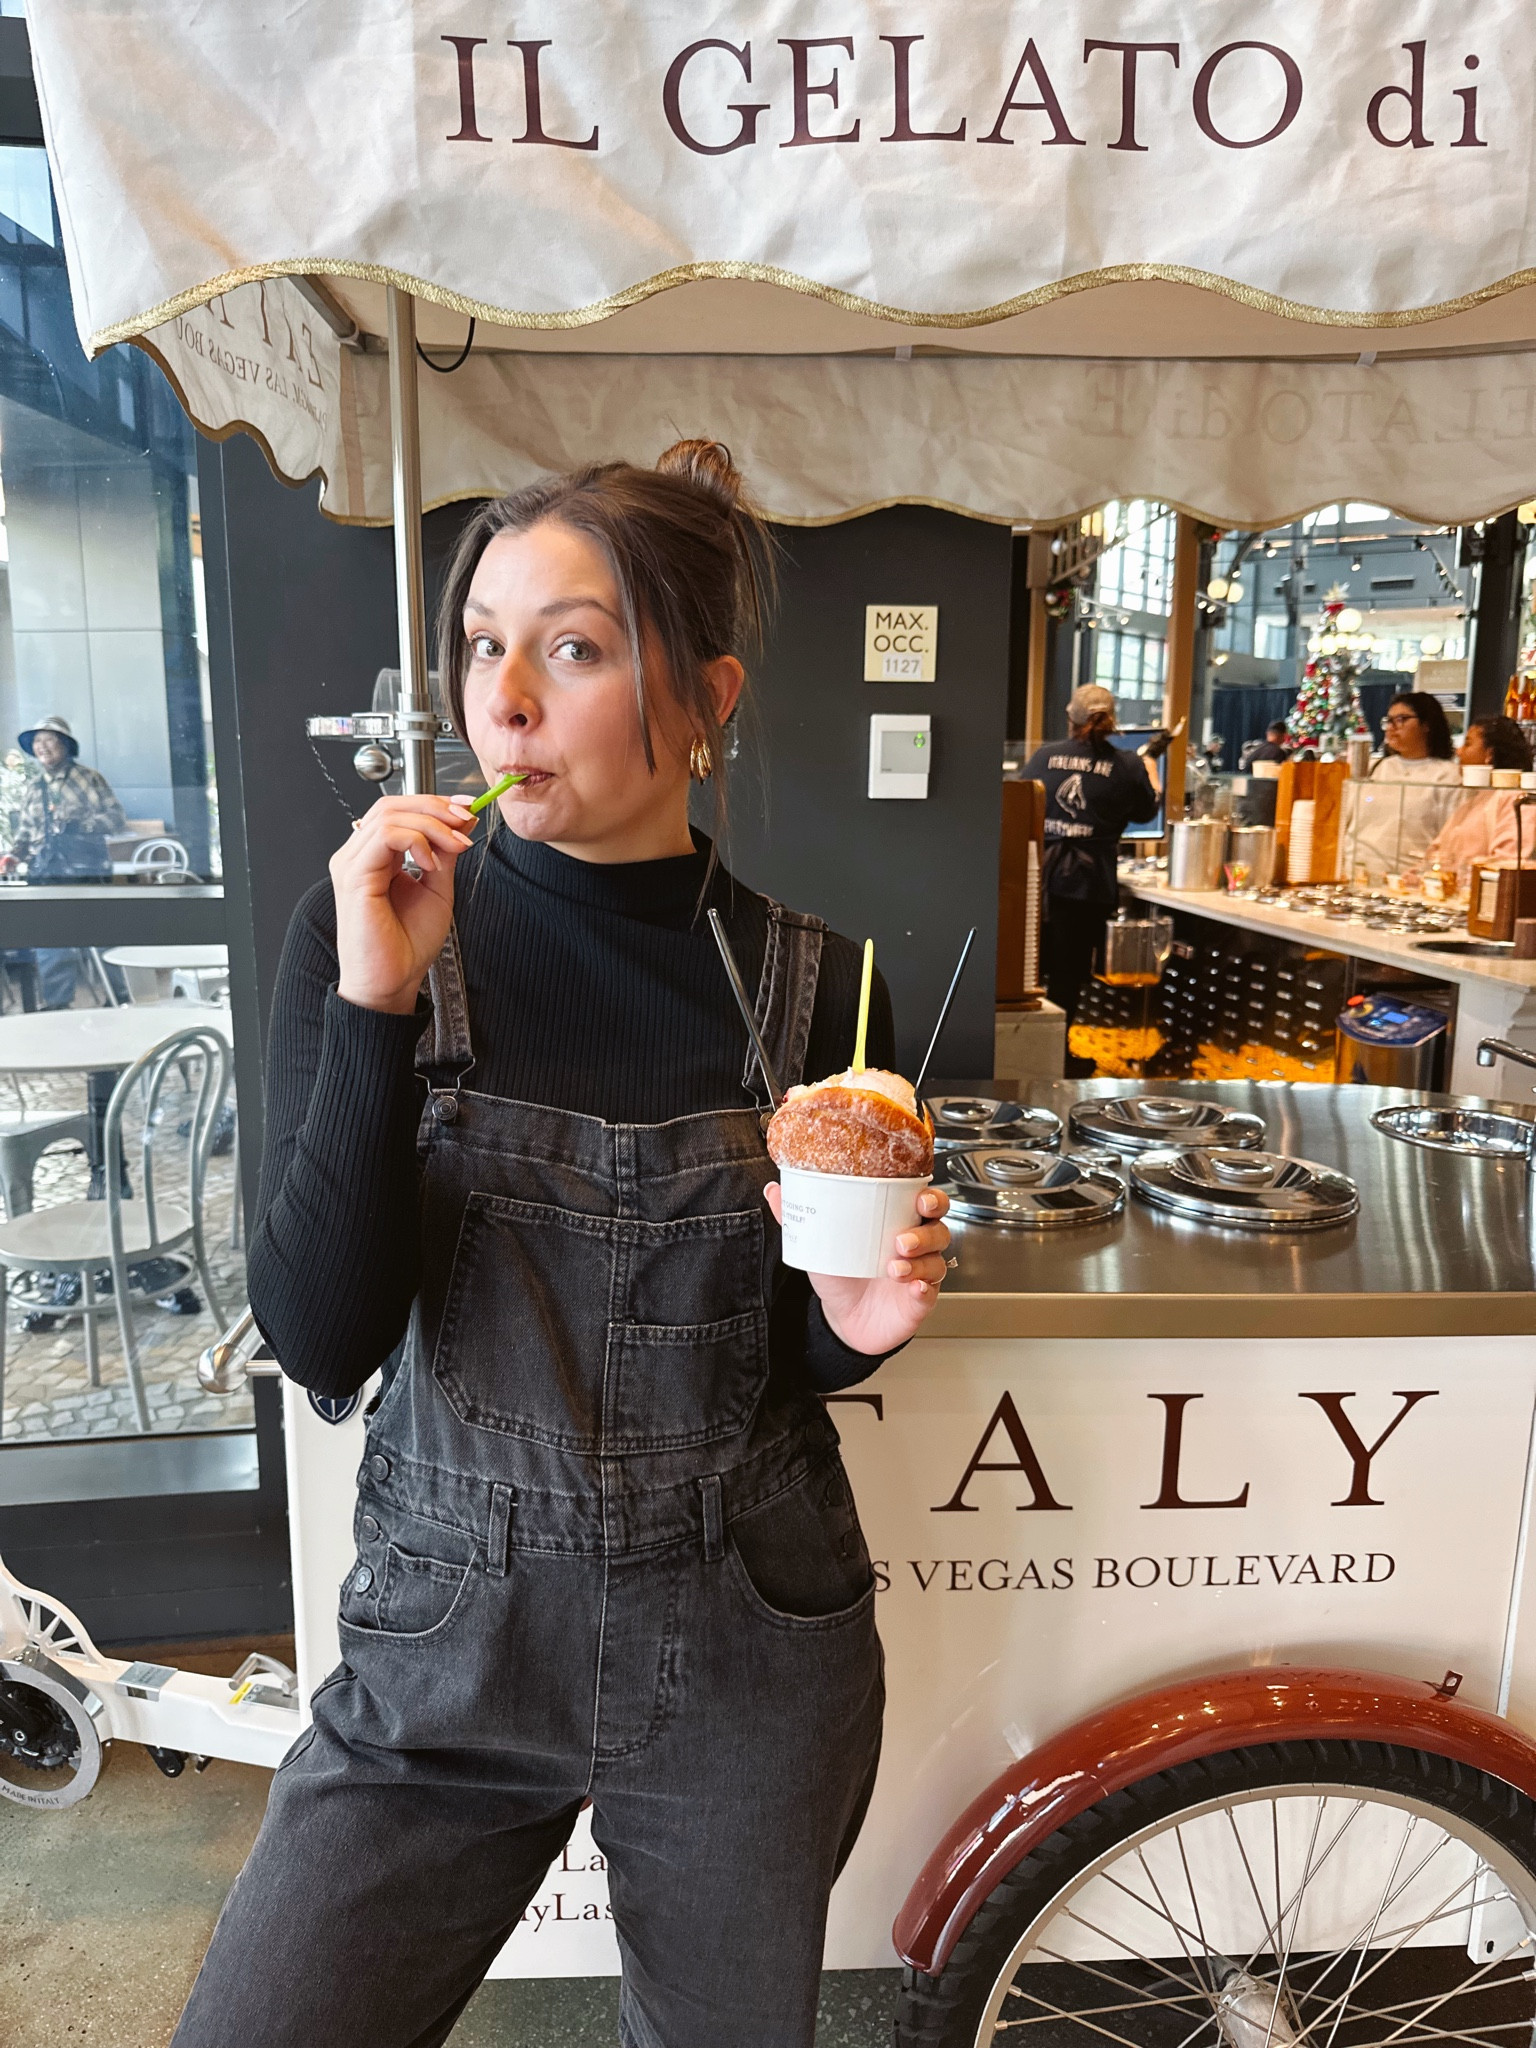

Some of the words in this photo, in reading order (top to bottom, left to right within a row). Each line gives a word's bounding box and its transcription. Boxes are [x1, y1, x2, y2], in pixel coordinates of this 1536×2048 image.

[441, 36, 599, 151] IL
[662, 35, 1303, 156] GELATO
[1366, 39, 1488, 150] di
[875, 612, 929, 630] MAX.
[874, 635, 929, 653] OCC.
[885, 659, 920, 674] 1127
[1047, 755, 1092, 773] ITALIANS
[1093, 760, 1114, 778] ARE
[805, 1206, 817, 1215] TO
[907, 1557, 1074, 1593] VEGAS
[1091, 1553, 1396, 1590] BOULEVARD
[2, 1785, 26, 1800] MADE
[38, 1797, 60, 1805] ITALY
